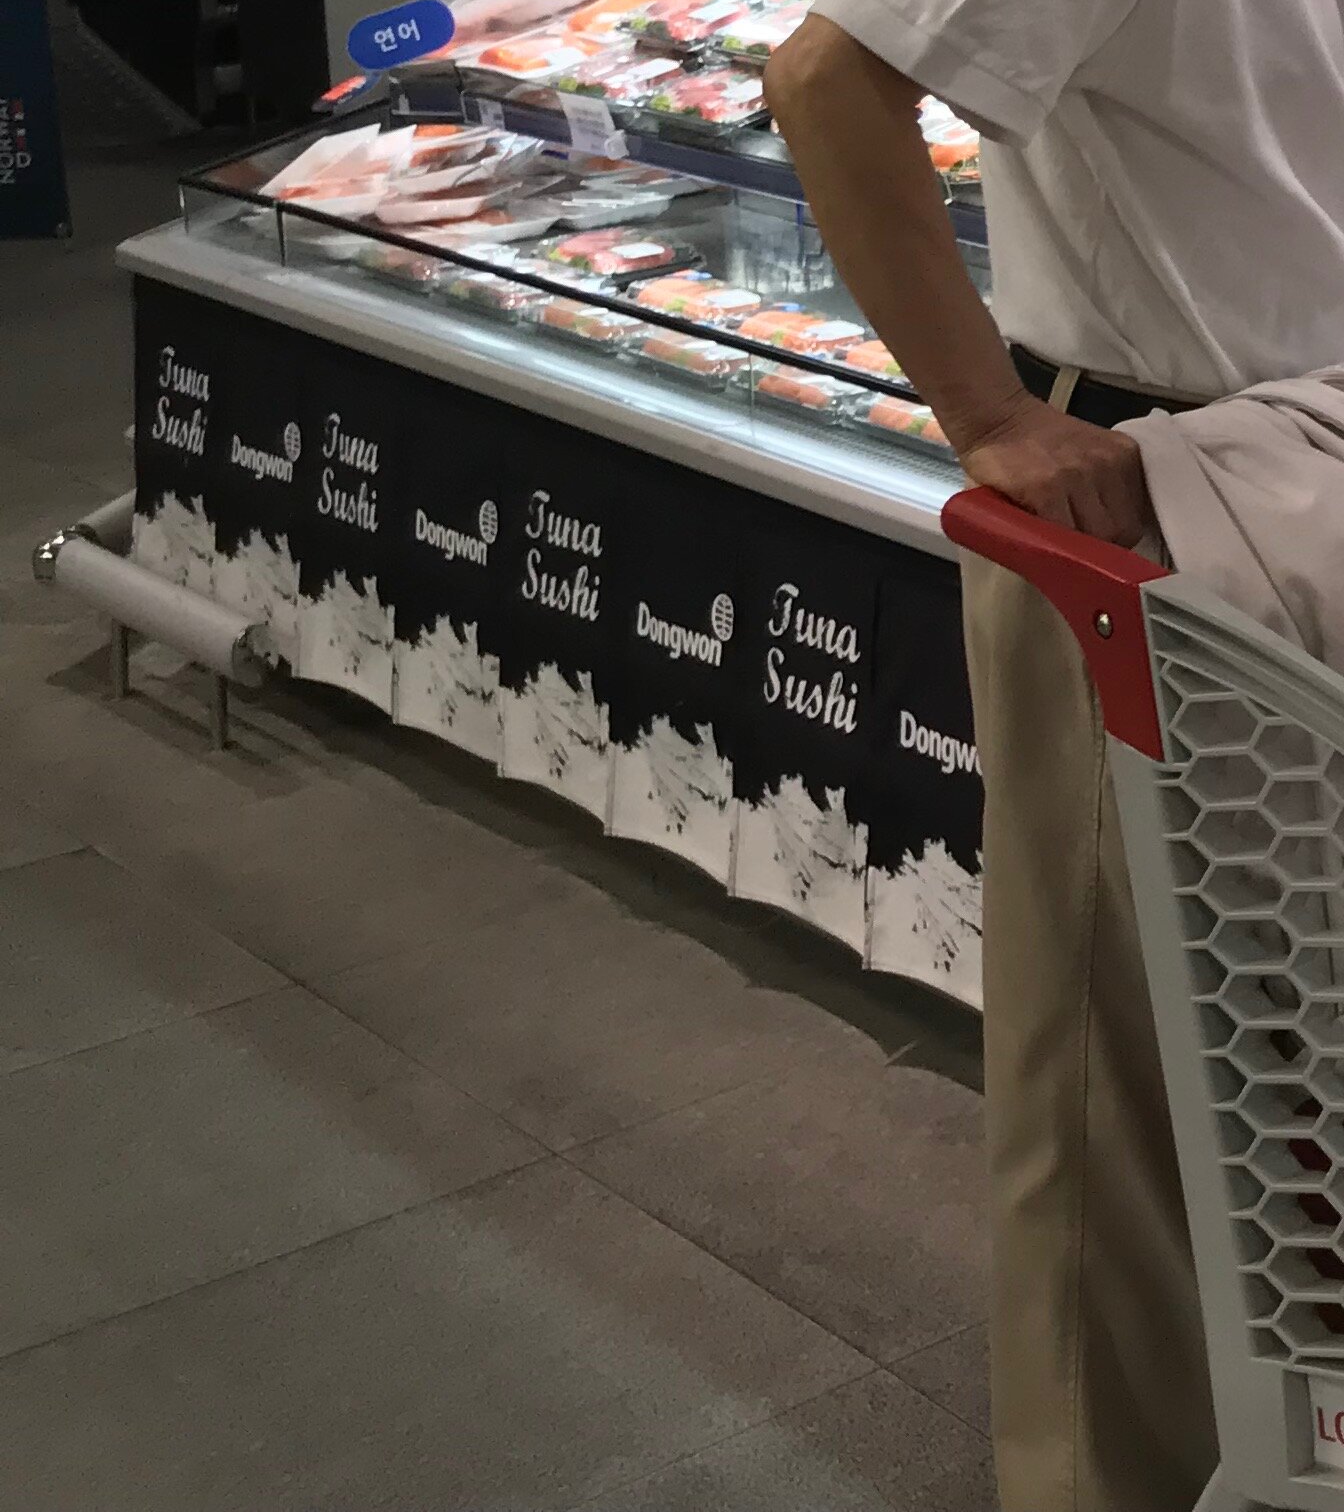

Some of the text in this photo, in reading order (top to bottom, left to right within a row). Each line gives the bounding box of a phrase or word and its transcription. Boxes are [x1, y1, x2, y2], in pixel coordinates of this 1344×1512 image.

[374, 19, 420, 53] 연어
[159, 345, 210, 402] Tuna
[152, 395, 207, 456] Sushi
[322, 412, 380, 475] Tuna
[231, 434, 293, 484] Dongwon
[316, 466, 379, 534] Sushi
[525, 489, 603, 557] Tuna
[415, 508, 488, 567] Dongwon
[521, 547, 600, 622] Sushi
[637, 601, 722, 667] Dongwon
[768, 582, 861, 664] Tuna
[763, 646, 858, 734] Sushi
[900, 710, 983, 776] Dongw
